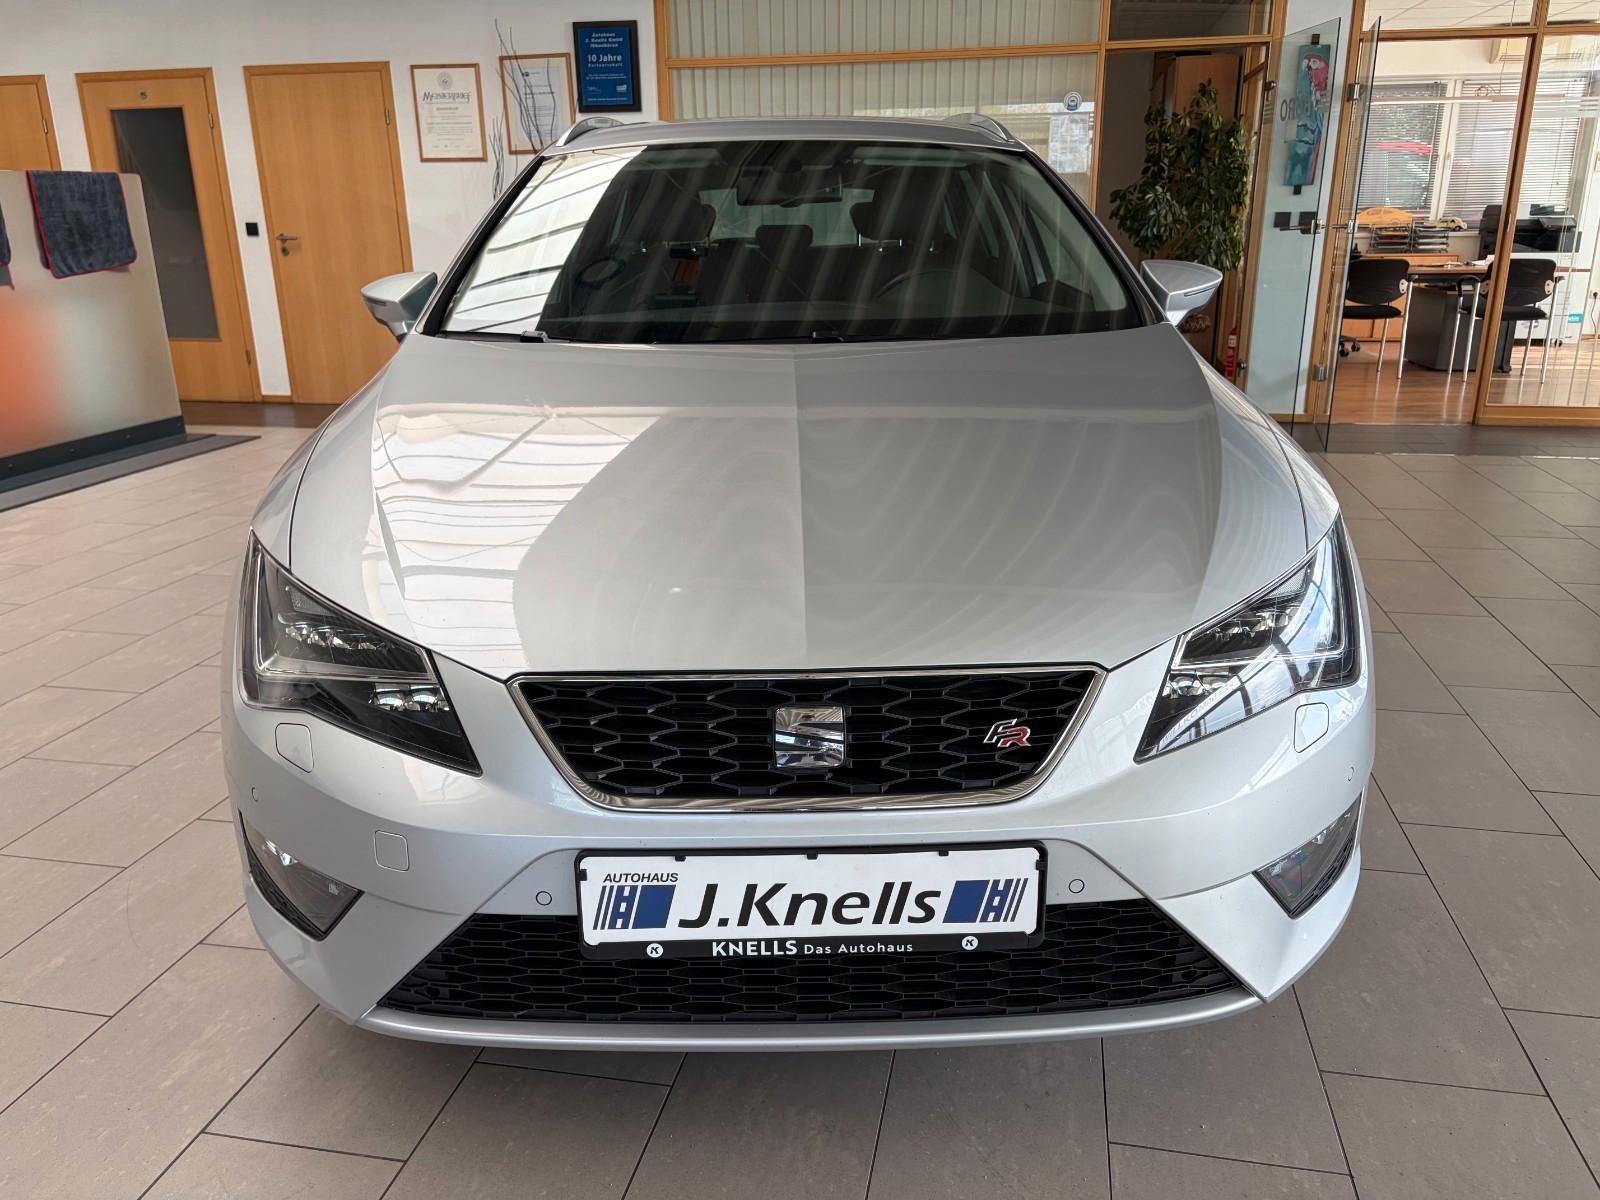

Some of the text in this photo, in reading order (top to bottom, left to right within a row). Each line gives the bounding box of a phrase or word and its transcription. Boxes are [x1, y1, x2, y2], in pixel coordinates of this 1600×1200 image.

[587, 54, 622, 62] 10 Jahre
[983, 718, 1032, 748] FR
[603, 872, 679, 883] AUTOHAUS
[678, 881, 941, 928] J.Knells
[712, 940, 914, 956] KNELLS Das Autohaus
